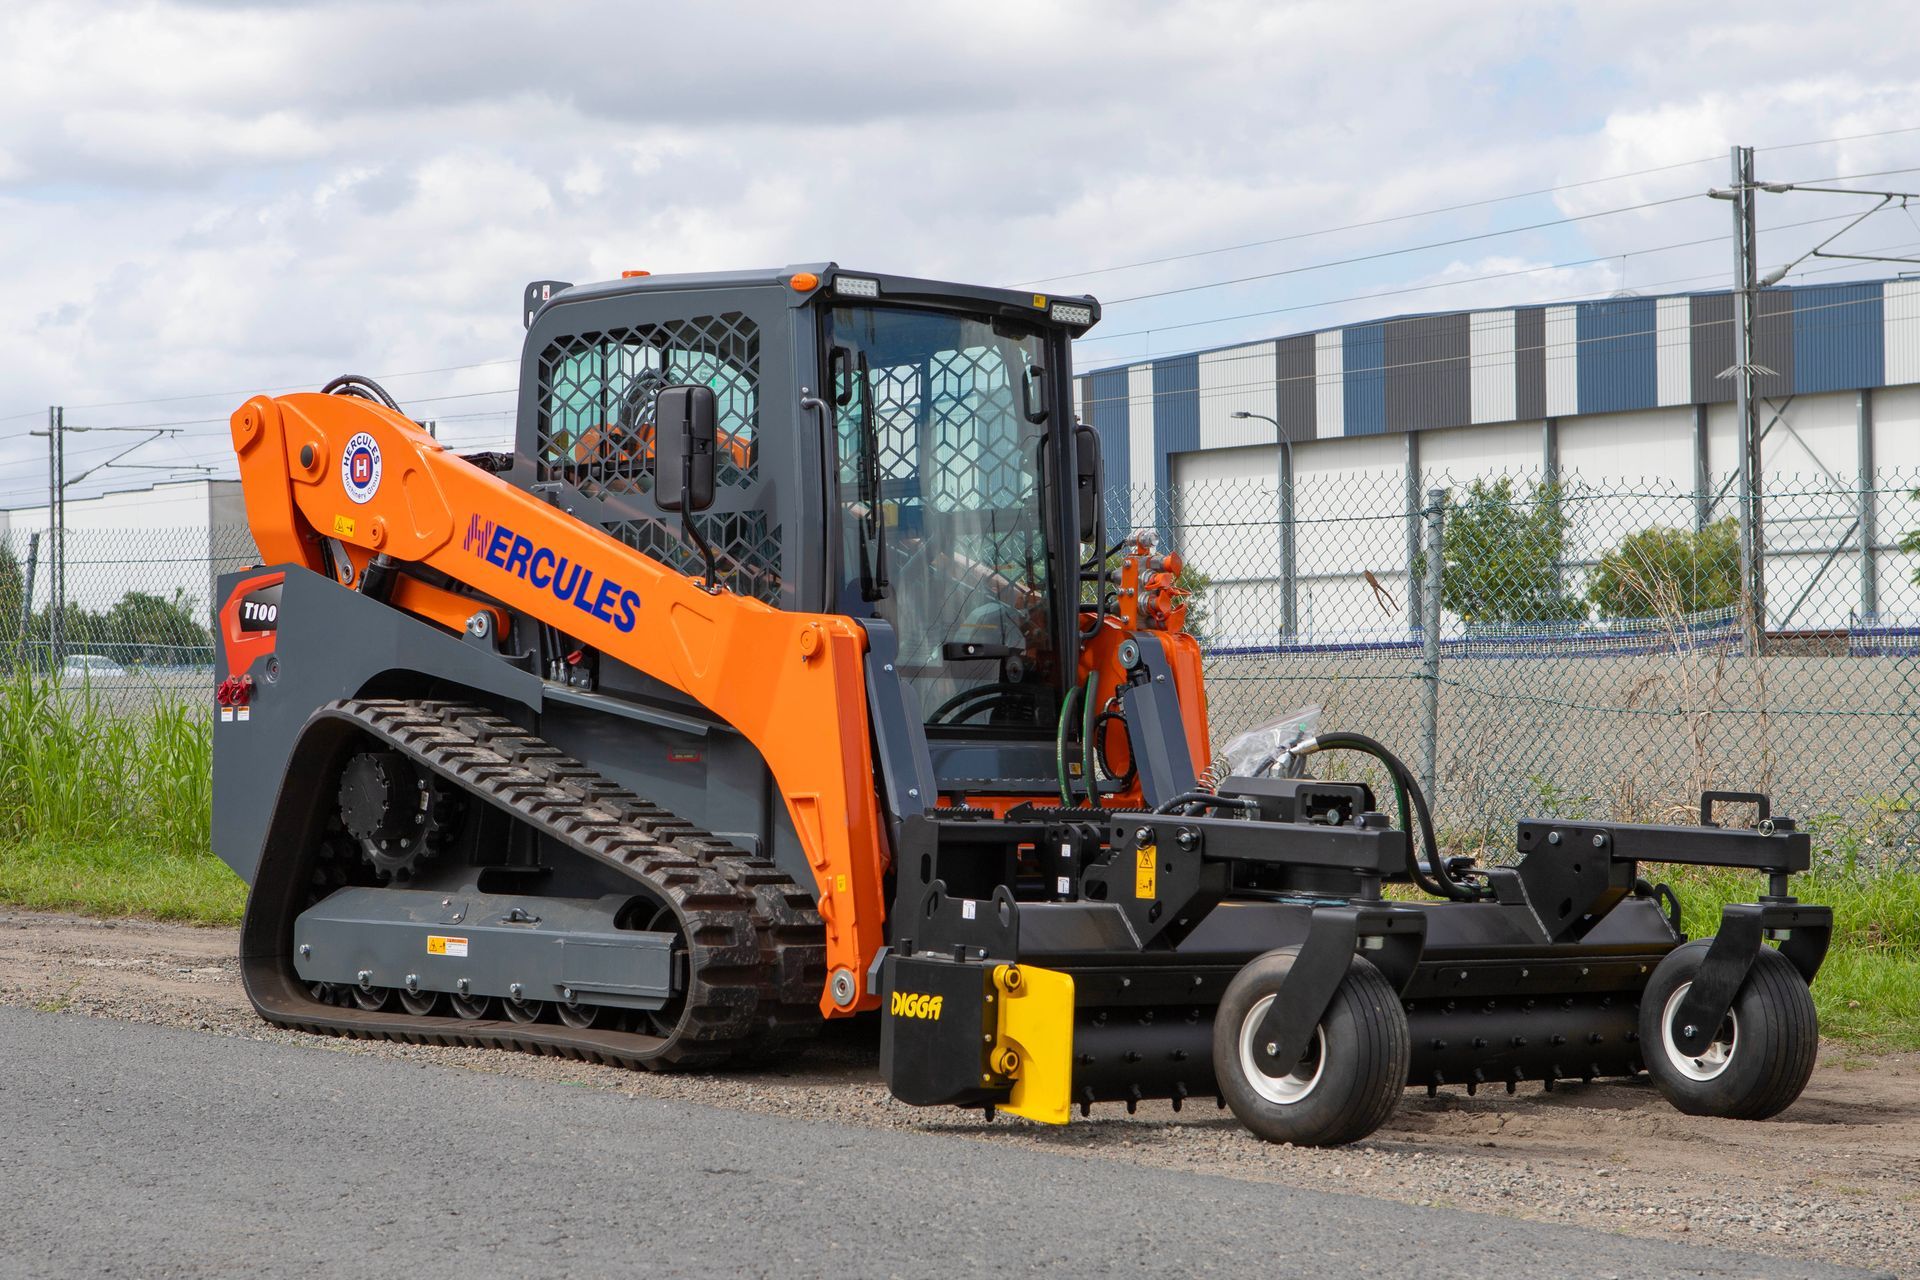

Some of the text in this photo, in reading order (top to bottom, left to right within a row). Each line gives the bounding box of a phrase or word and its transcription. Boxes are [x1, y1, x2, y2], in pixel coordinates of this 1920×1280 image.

[344, 435, 380, 467] HERCULES
[356, 459, 367, 478] H
[344, 470, 380, 500] Machinery Group
[464, 512, 642, 634] HERCULES
[245, 601, 277, 622] T100
[891, 991, 943, 1021] DIGGA
